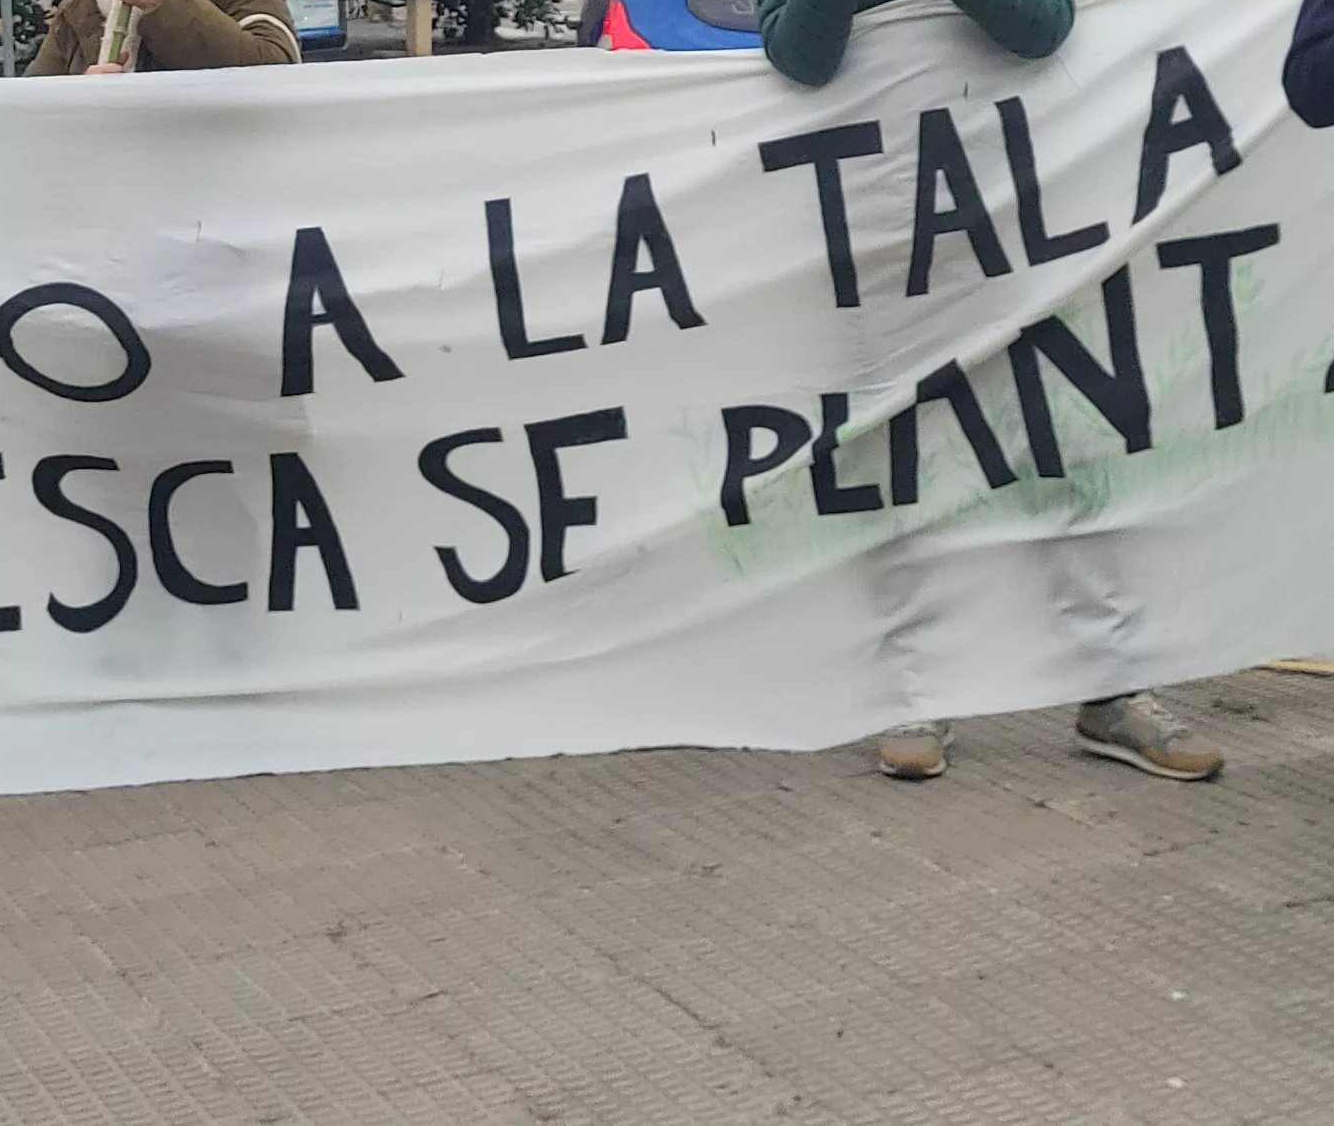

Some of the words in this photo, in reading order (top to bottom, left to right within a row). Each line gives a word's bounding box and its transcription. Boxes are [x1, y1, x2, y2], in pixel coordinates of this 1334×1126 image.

[280, 226, 407, 398] A
[485, 173, 708, 362] LA
[758, 45, 1244, 310] TALA
